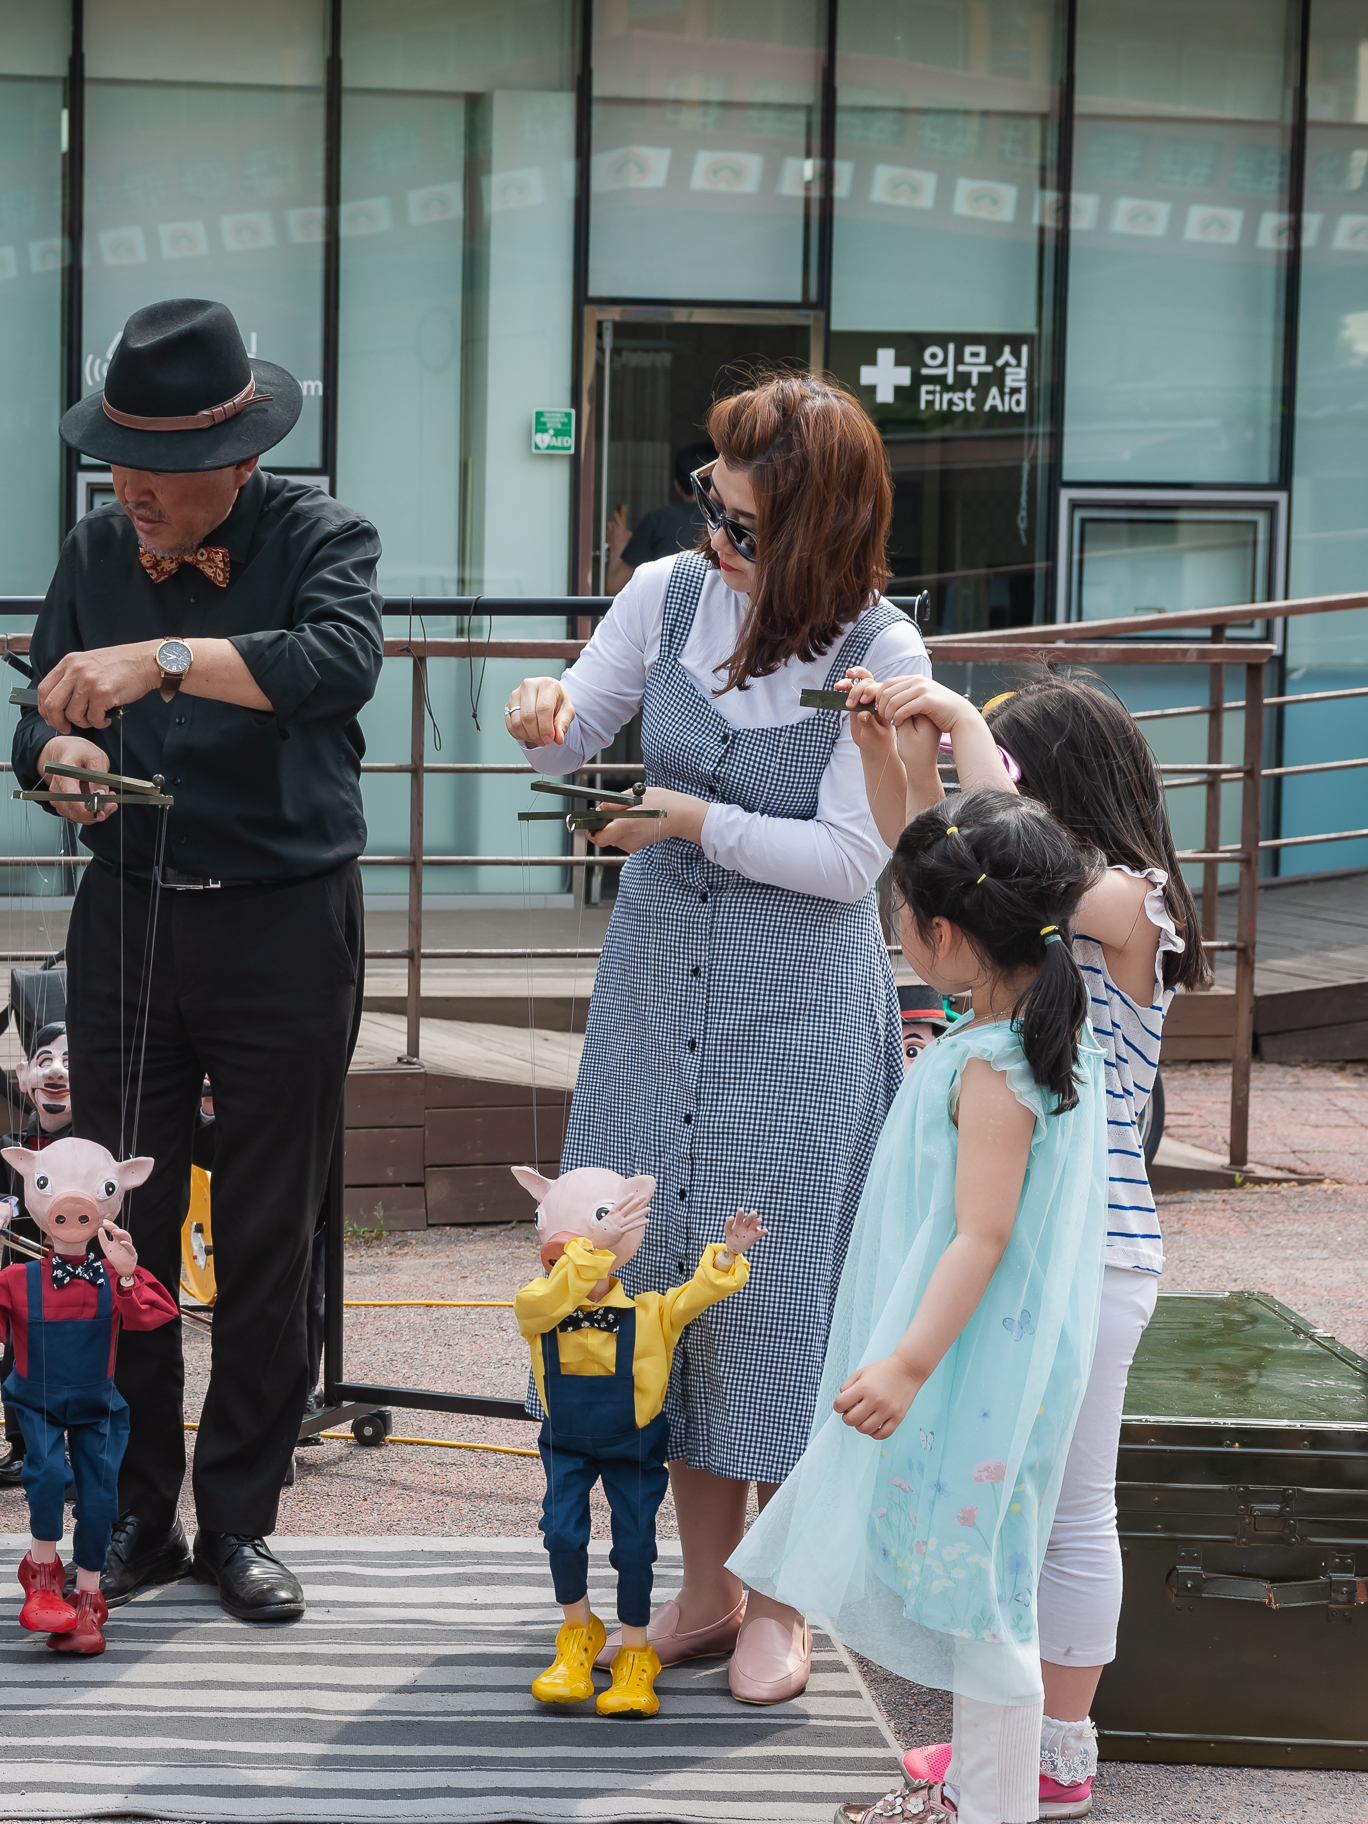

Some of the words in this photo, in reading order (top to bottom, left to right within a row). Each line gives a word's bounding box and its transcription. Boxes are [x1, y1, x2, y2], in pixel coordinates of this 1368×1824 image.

[920, 342, 1029, 388] 의무실
[920, 385, 976, 412] First
[984, 386, 1027, 413] Aid
[549, 436, 572, 447] AED
